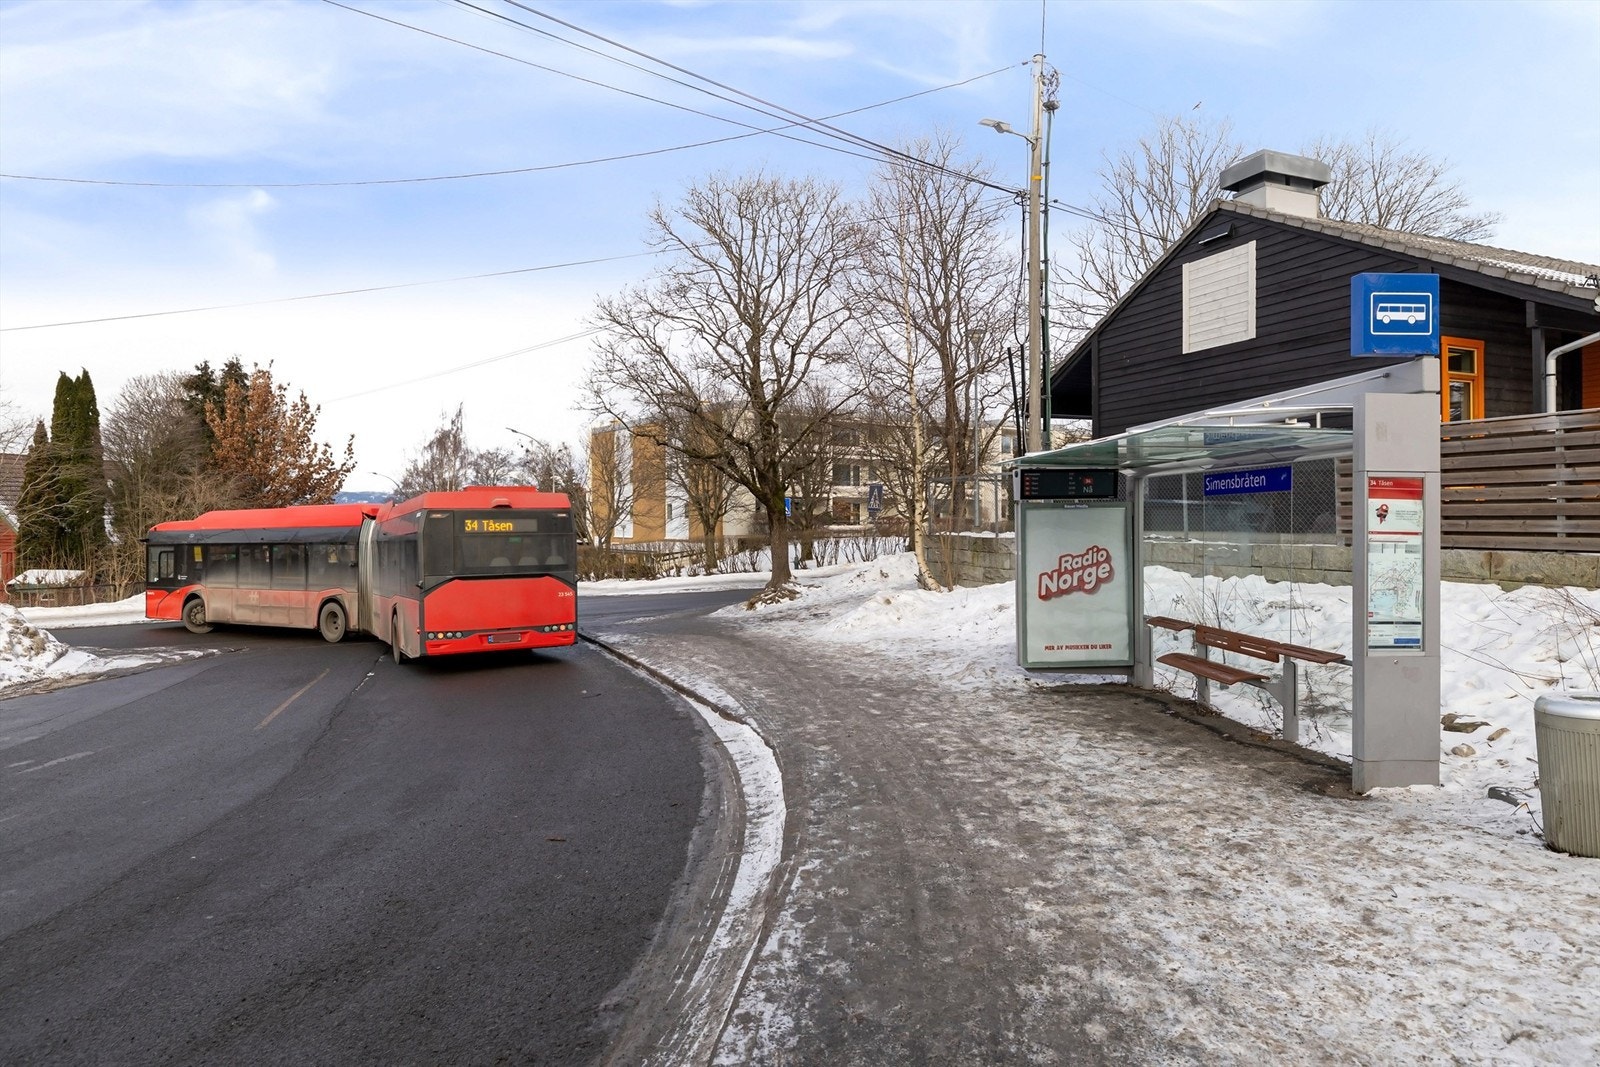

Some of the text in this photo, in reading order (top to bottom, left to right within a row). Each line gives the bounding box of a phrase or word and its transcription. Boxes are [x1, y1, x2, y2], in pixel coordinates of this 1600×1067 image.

[1205, 472, 1266, 491] Simensbråten
[465, 519, 513, 531] 34 Tåsen
[1060, 546, 1108, 572] Radio
[1040, 562, 1111, 596] Norge
